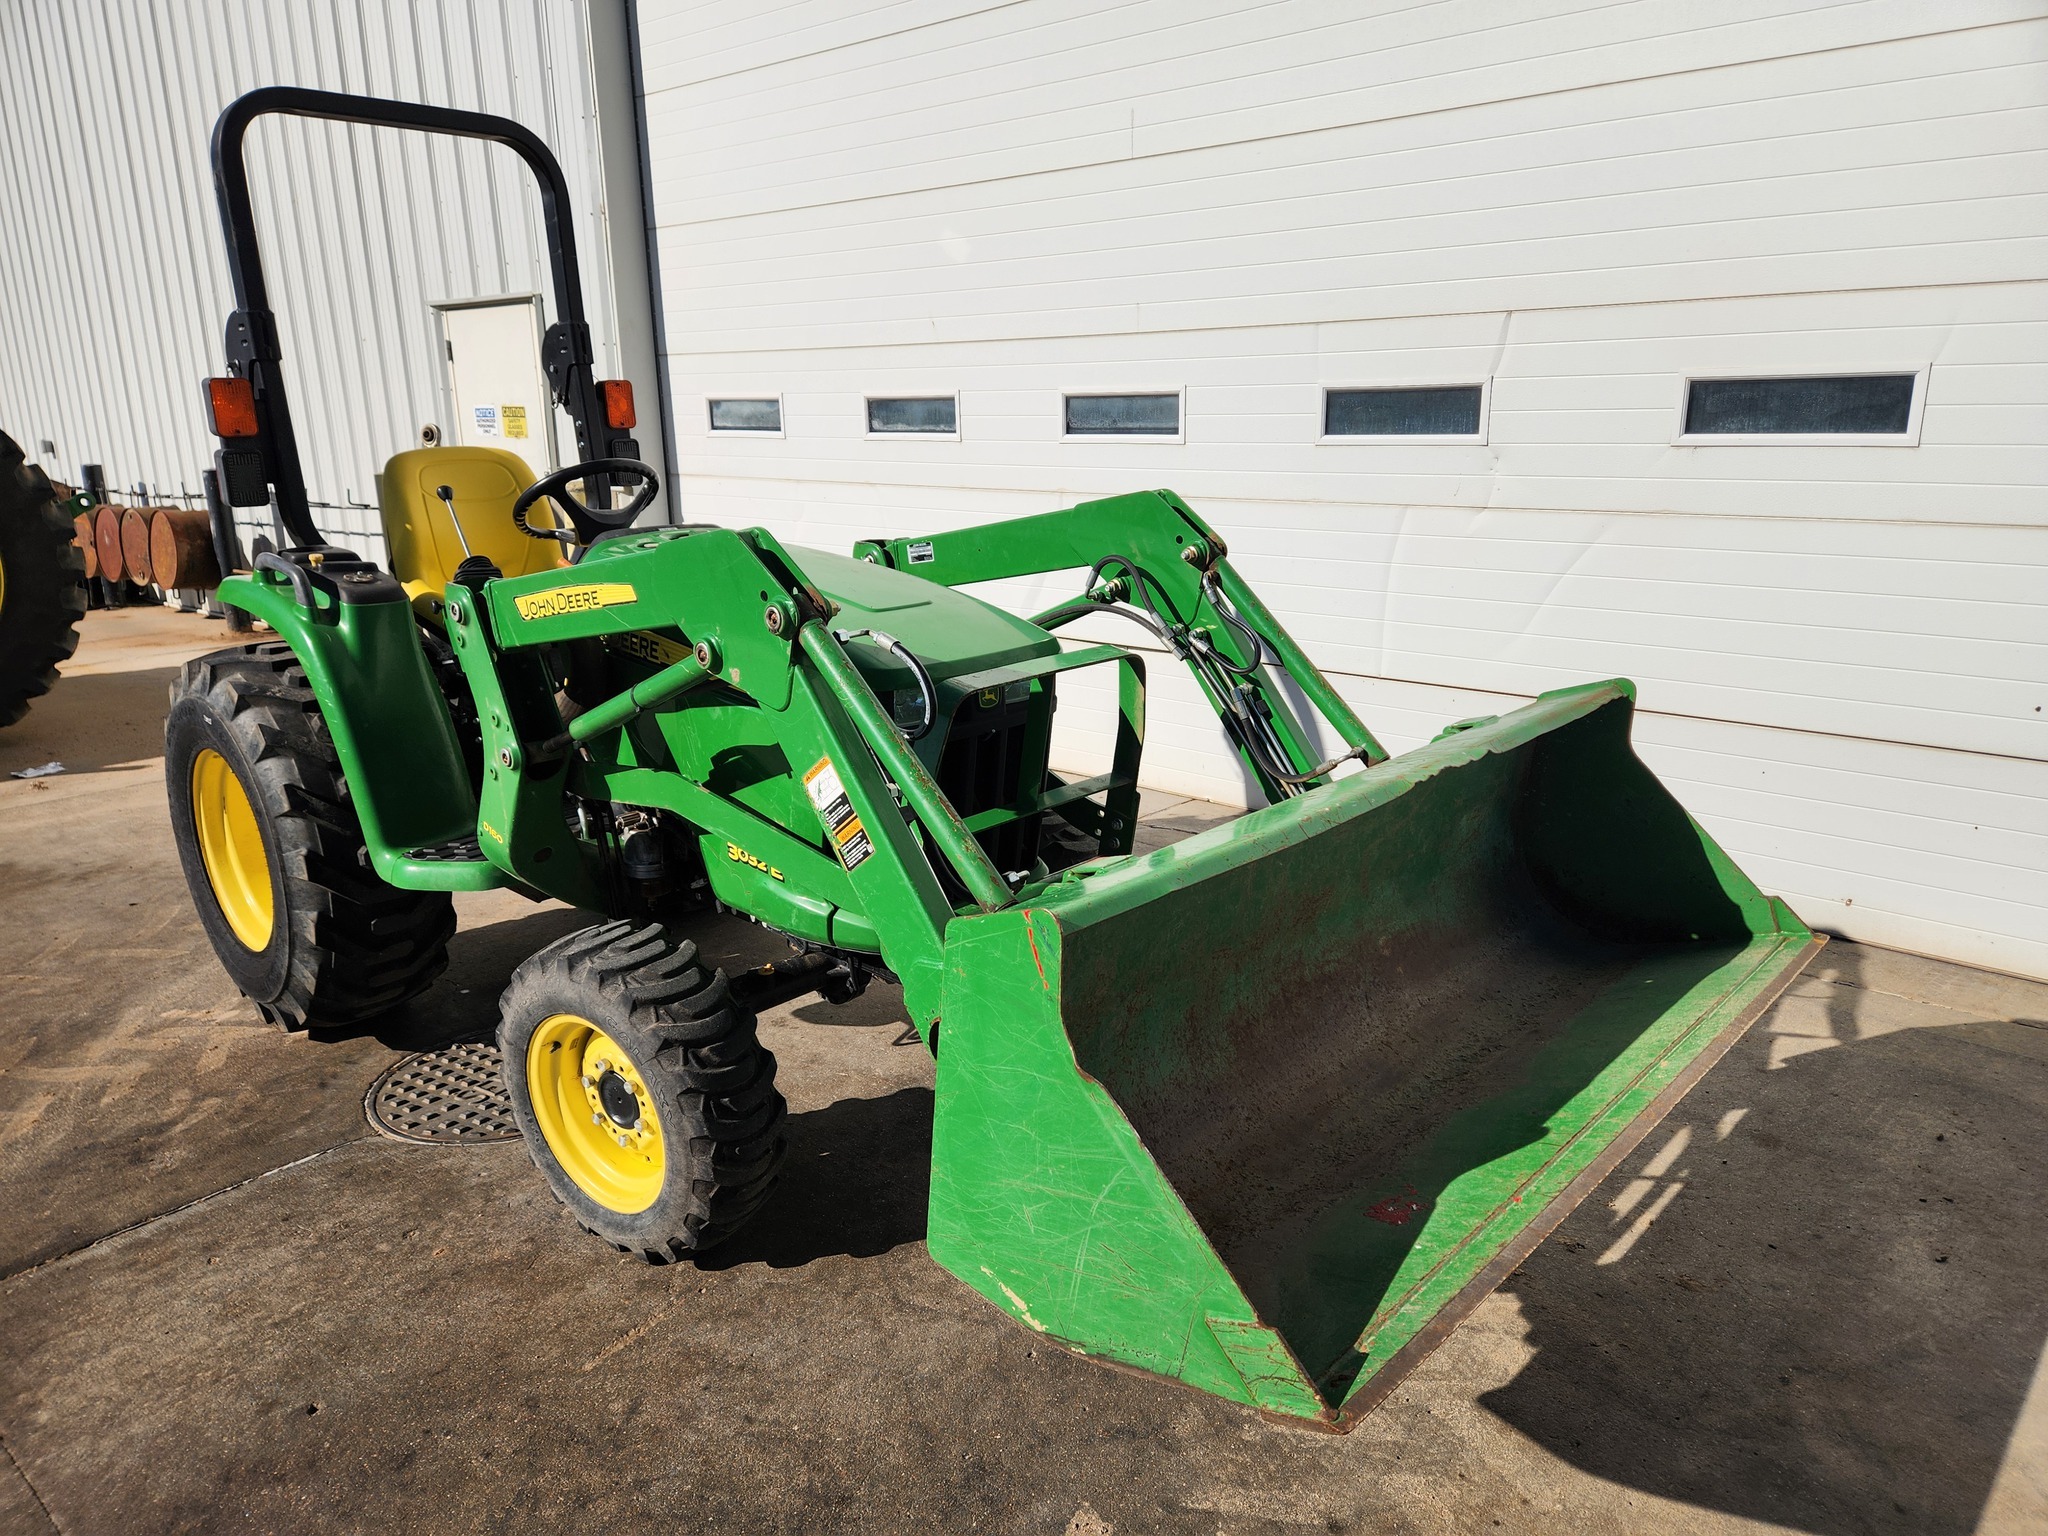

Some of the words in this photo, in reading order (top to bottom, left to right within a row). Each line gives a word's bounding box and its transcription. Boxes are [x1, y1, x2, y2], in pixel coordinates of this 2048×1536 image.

[475, 408, 495, 417] NOTICE
[502, 407, 526, 417] CAUTION
[524, 598, 555, 618] JOHN
[556, 590, 600, 611] DEERE
